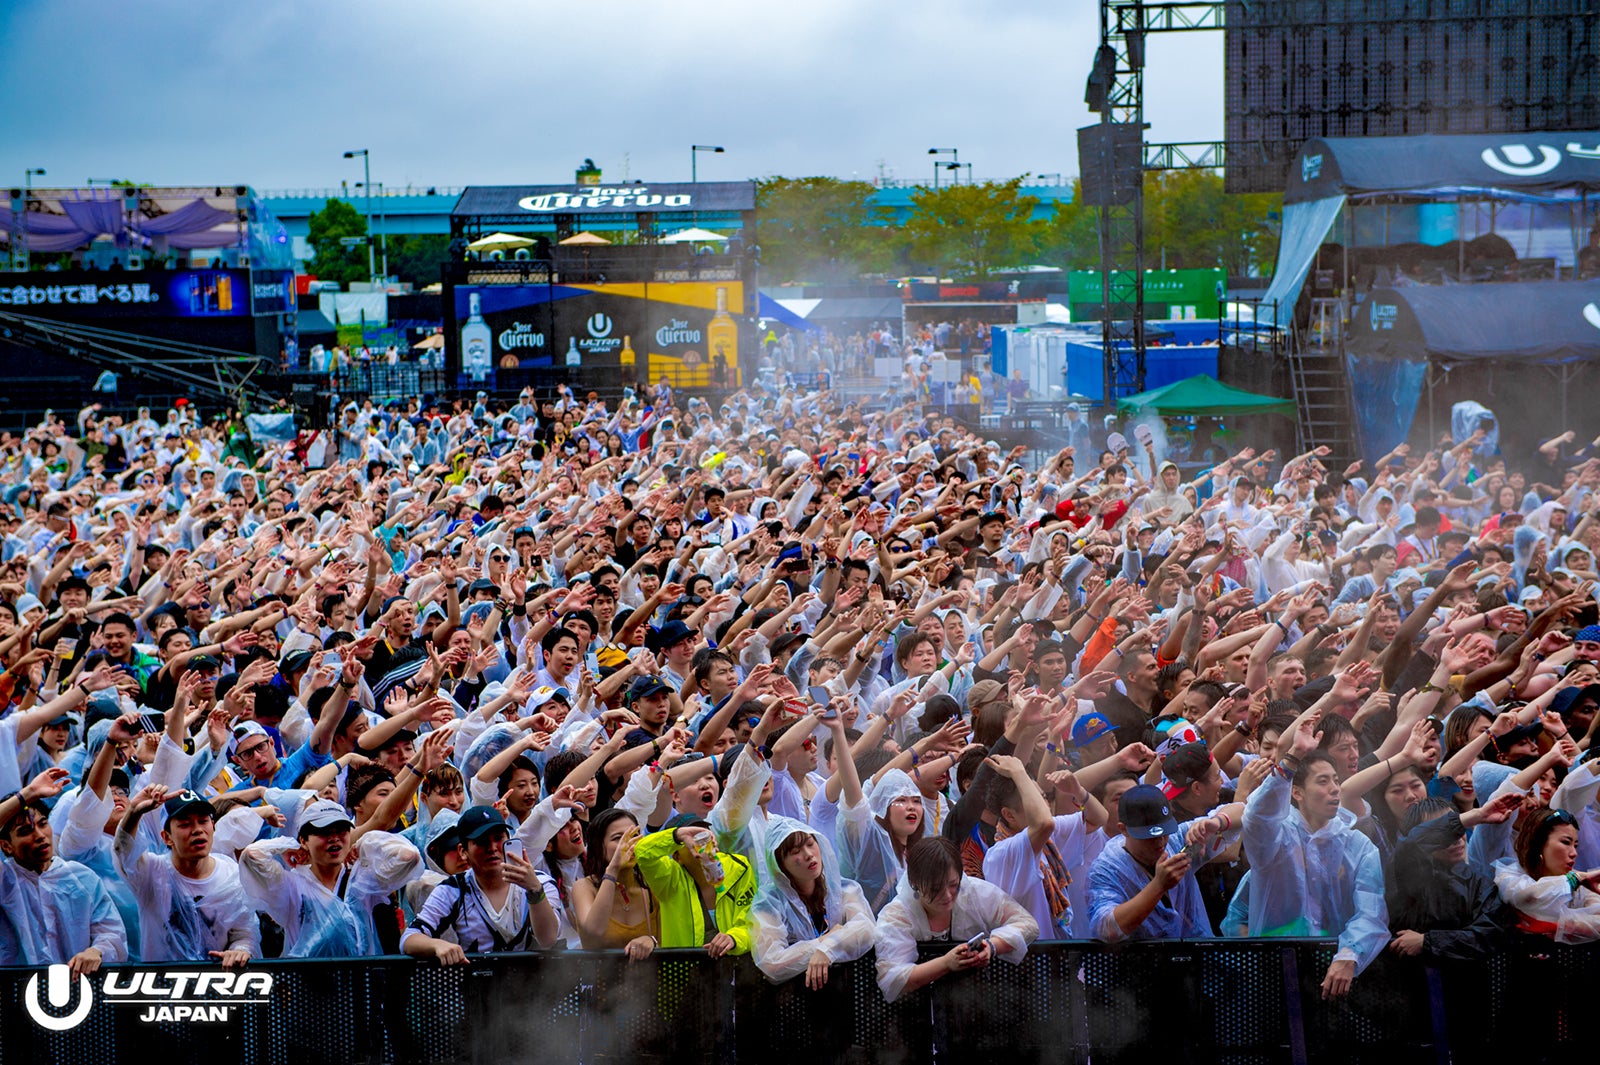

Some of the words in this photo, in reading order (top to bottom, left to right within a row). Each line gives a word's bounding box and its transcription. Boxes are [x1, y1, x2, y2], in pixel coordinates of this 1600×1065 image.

[577, 187, 648, 197] Jose
[518, 191, 692, 211] Cuervo
[512, 321, 532, 333] Jose
[670, 318, 689, 331] Jose
[498, 328, 545, 351] Cuervo
[579, 338, 621, 346] ULTRA
[655, 325, 701, 347] Cuervo
